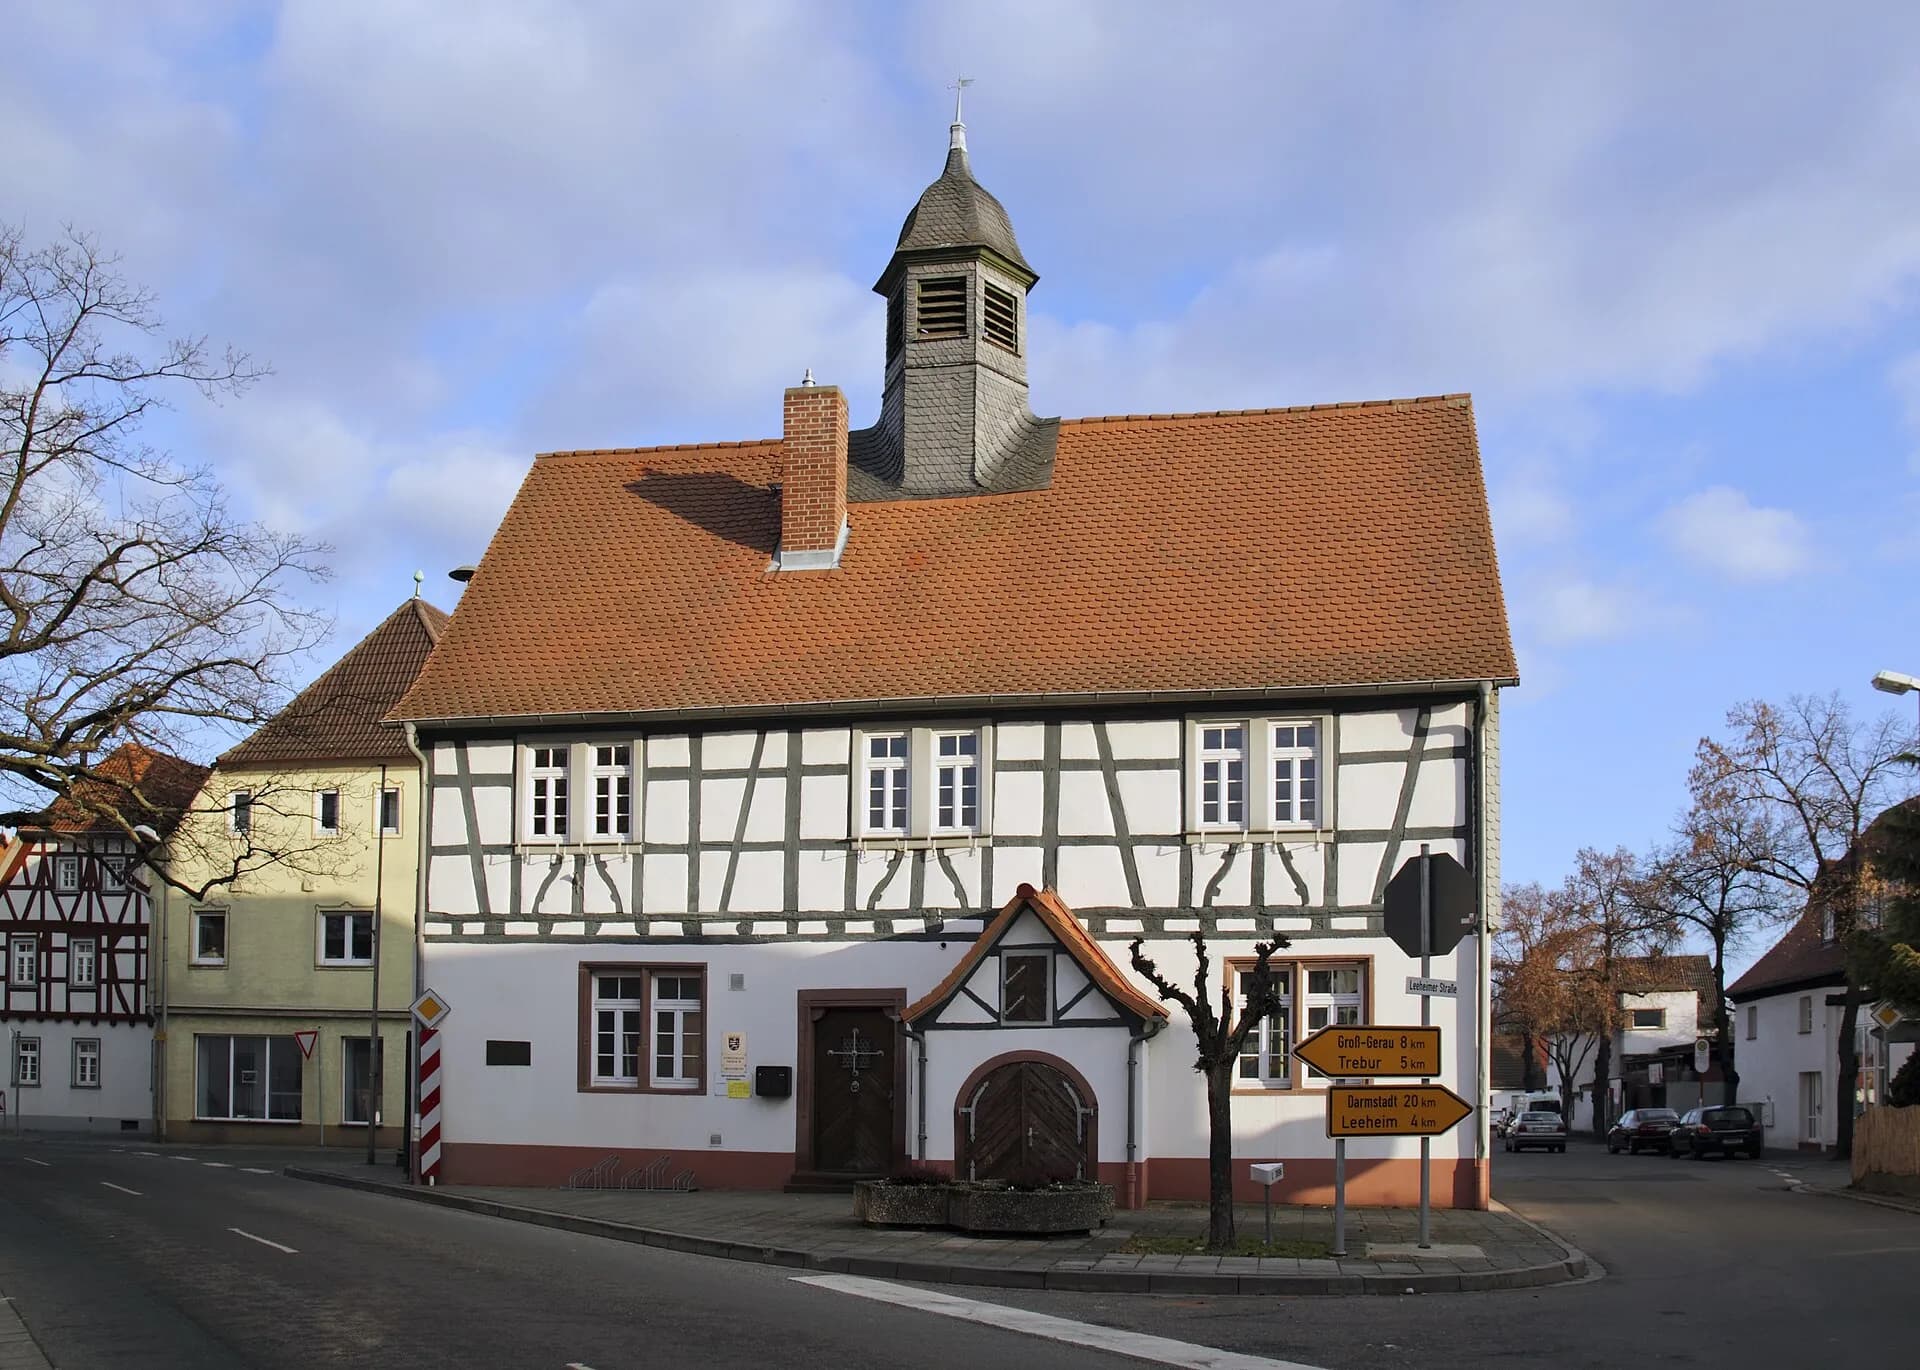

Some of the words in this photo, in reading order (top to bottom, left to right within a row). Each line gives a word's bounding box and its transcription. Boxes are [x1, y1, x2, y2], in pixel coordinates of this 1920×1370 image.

[1409, 979, 1438, 992] Leeheimer
[1439, 982, 1457, 994] Straße
[1338, 1035, 1394, 1049] Groß-Gerau
[1400, 1036, 1407, 1048] 8
[1411, 1039, 1425, 1049] km
[1338, 1056, 1382, 1069] Trebur
[1400, 1056, 1407, 1069] 5
[1411, 1059, 1425, 1069] km
[1347, 1095, 1398, 1108] Darmstadt
[1404, 1095, 1419, 1107] 20
[1421, 1096, 1436, 1107] km
[1342, 1116, 1398, 1129] Leeheim
[1410, 1115, 1418, 1127] 4
[1421, 1116, 1436, 1127] km
